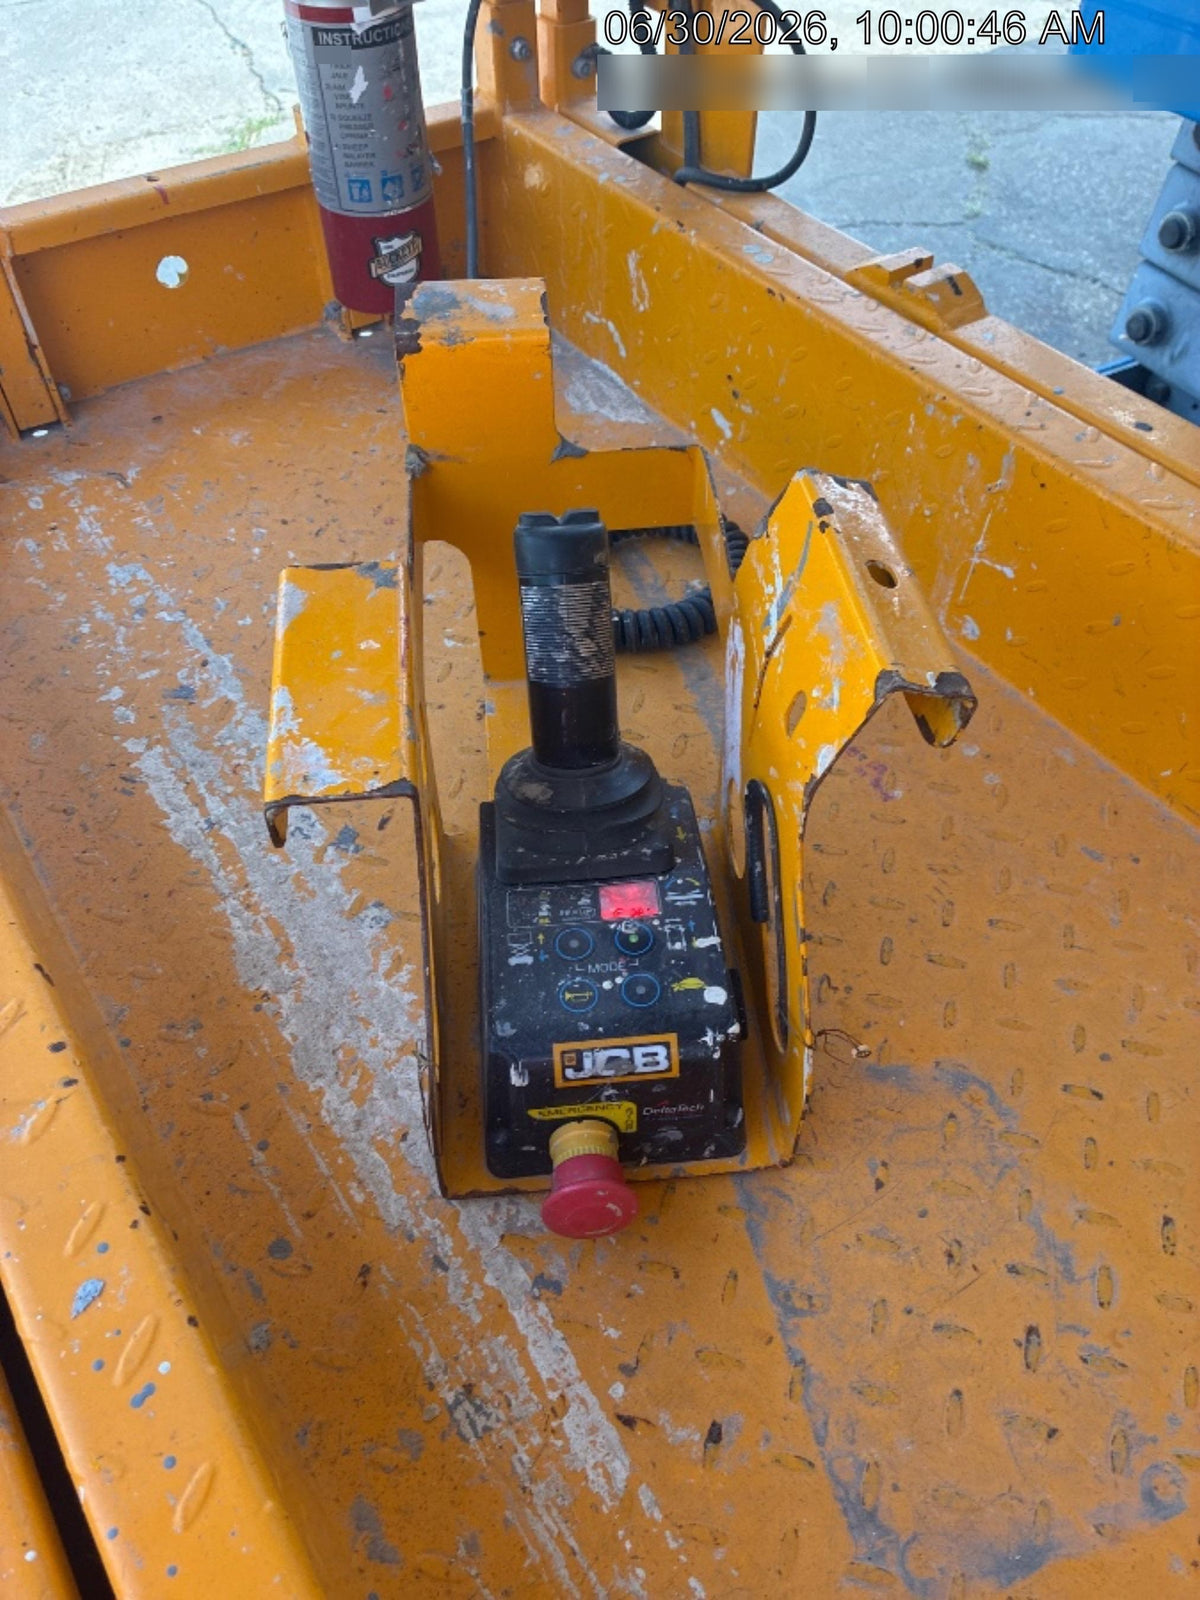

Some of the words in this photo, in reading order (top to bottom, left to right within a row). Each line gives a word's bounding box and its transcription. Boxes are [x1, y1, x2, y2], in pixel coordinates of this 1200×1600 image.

[317, 20, 412, 46] INSTRUCTIO
[587, 961, 627, 974] MODE
[565, 1045, 669, 1080] JCB
